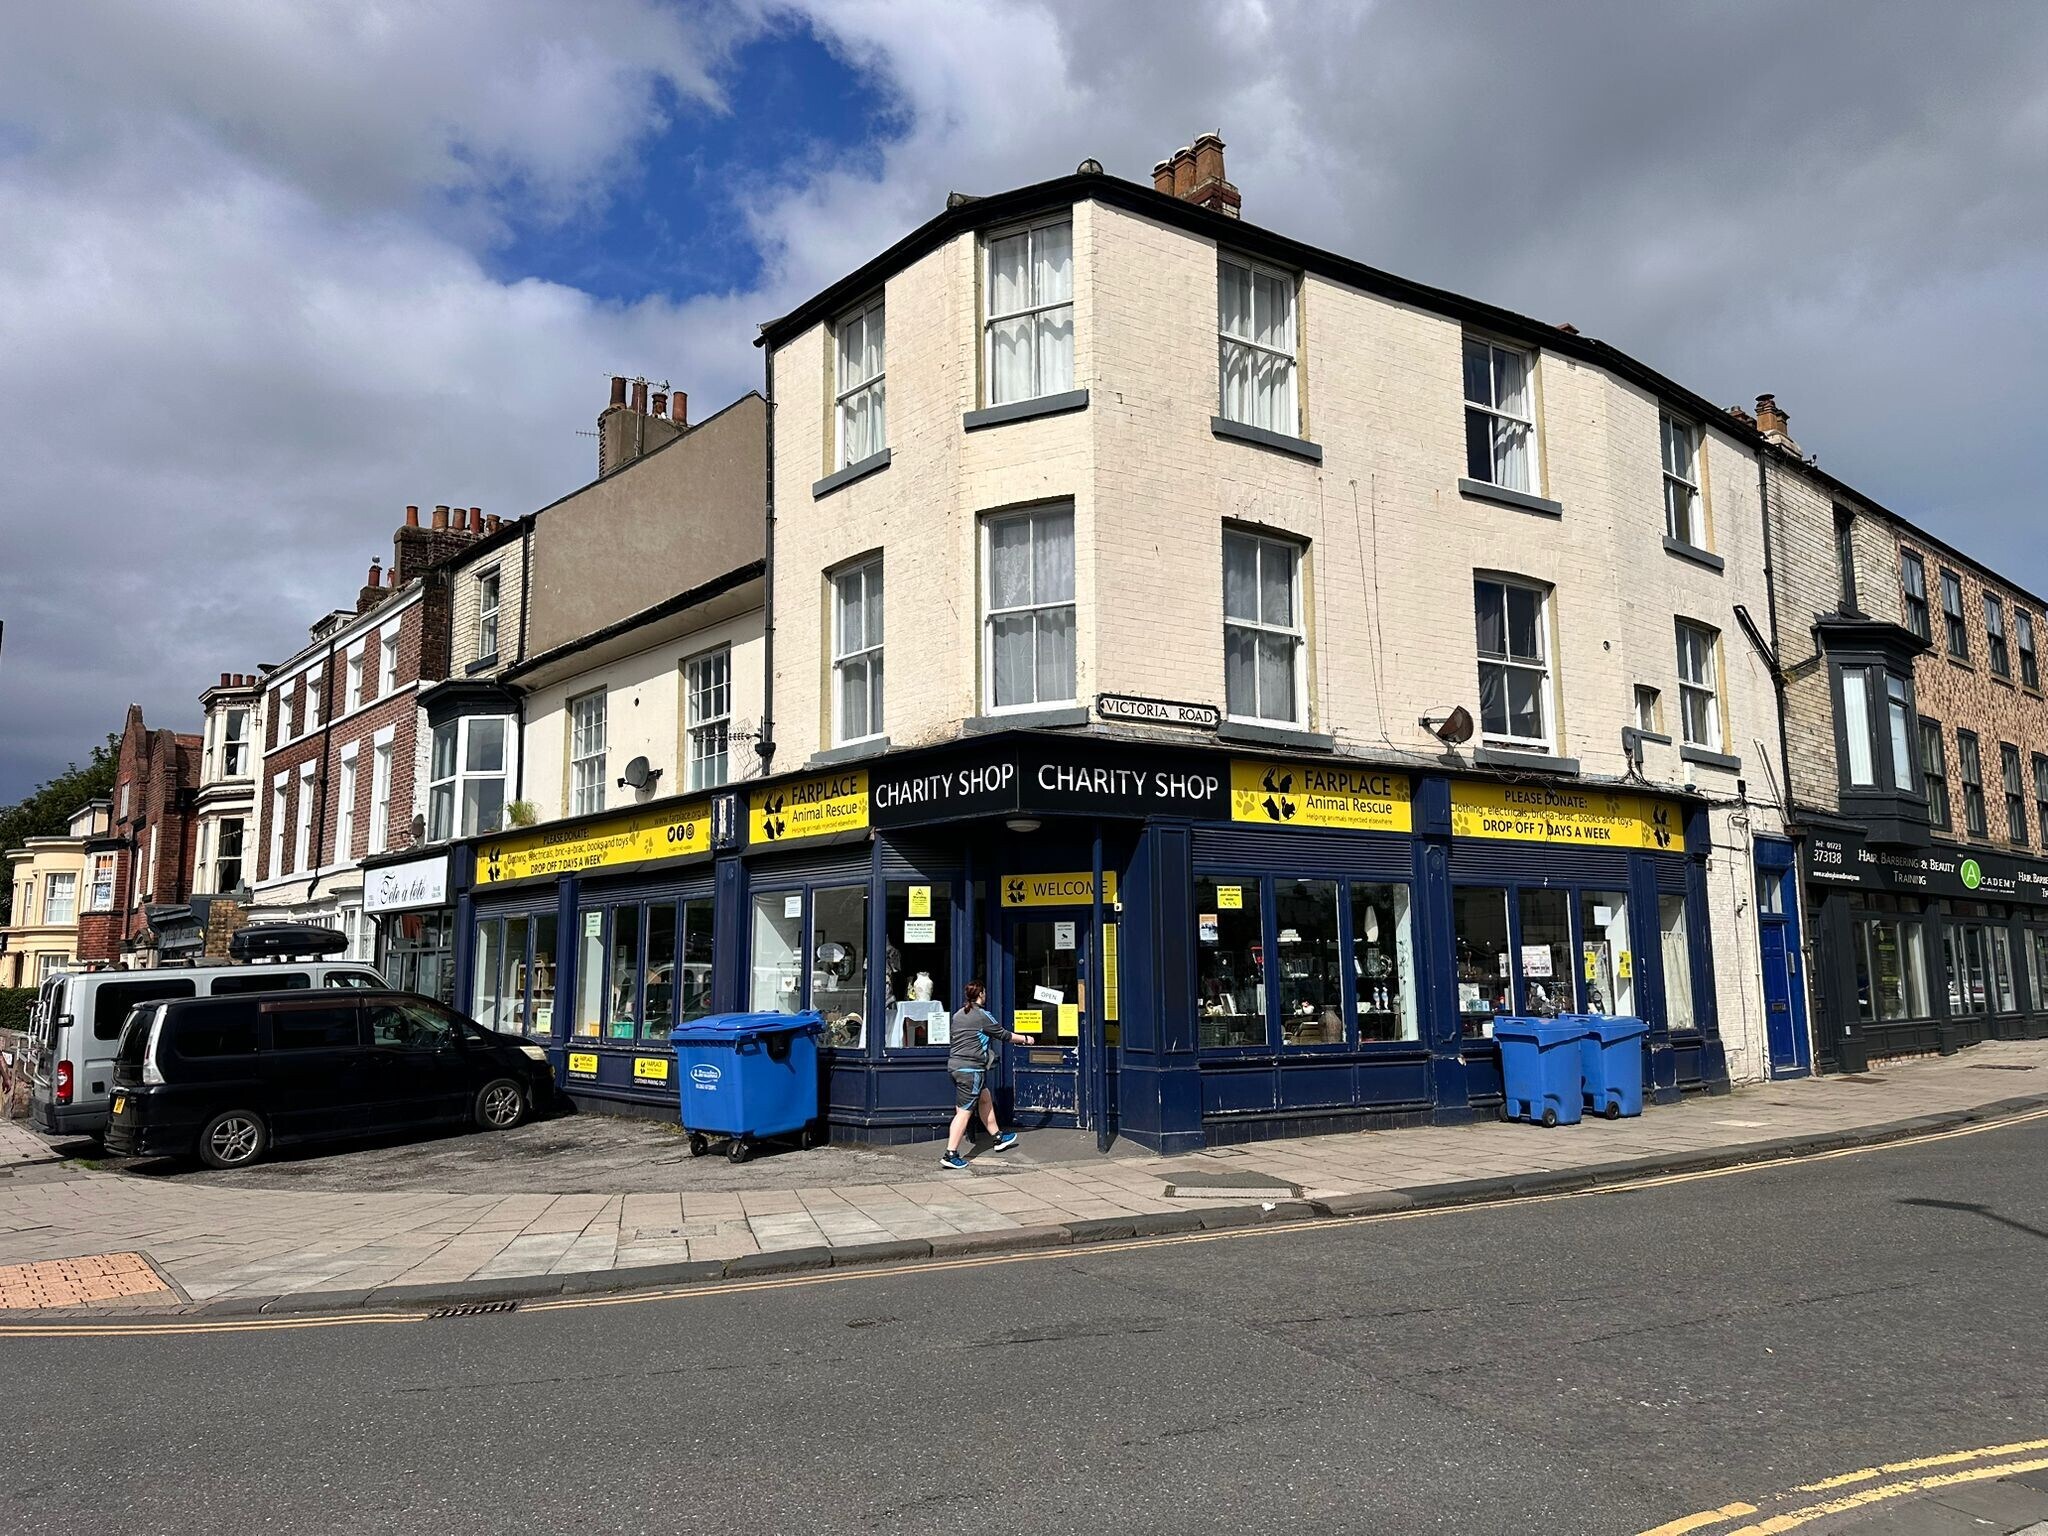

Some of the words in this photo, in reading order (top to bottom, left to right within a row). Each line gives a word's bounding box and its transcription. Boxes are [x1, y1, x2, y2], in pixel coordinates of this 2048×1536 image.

[1106, 700, 1168, 718] VICTORIA
[1179, 707, 1212, 723] ROAD
[791, 776, 857, 805] FARPLACE
[876, 773, 953, 808] CHARITY
[959, 763, 1014, 796] SHOP
[1038, 764, 1147, 796] CHARITY
[1155, 772, 1219, 800] SHOP
[1305, 770, 1391, 796] FARPLACE
[1306, 794, 1349, 811] Animal
[1353, 797, 1392, 814] Rescue
[1504, 790, 1543, 805] PLEASE
[1544, 792, 1588, 808] DONATE:
[792, 806, 824, 823] Animal
[826, 803, 858, 818] Rescue
[1306, 813, 1326, 823] Helping
[1327, 814, 1347, 822] animals
[1348, 816, 1368, 824] rejected
[1369, 817, 1393, 825] elsewhere
[1450, 802, 1486, 817] Clothing,
[1488, 805, 1531, 820] electricals,
[1531, 808, 1577, 823] bric-a-brac,
[1578, 813, 1600, 824] books
[1602, 816, 1616, 825] and
[1617, 816, 1633, 828] toys
[543, 832, 563, 845] PLEASE
[1483, 820, 1512, 832] DROP
[1515, 821, 1534, 834] OFF
[1538, 823, 1544, 835] 7
[1546, 824, 1572, 837] DAYS
[1575, 827, 1582, 838] A
[1584, 827, 1611, 840] WEEK
[587, 839, 604, 853] books
[605, 837, 615, 849] and
[616, 836, 629, 849] toys
[531, 862, 546, 875] DROP
[547, 860, 557, 872] OFF
[558, 859, 562, 870] 7
[563, 857, 578, 869] DAYS
[578, 857, 583, 867] A
[584, 854, 601, 867] WEEK
[1813, 849, 1842, 864] 373138
[1920, 860, 1928, 870] &
[1929, 859, 1955, 873] BEAUTY
[1041, 991, 1057, 1001] OPEN
